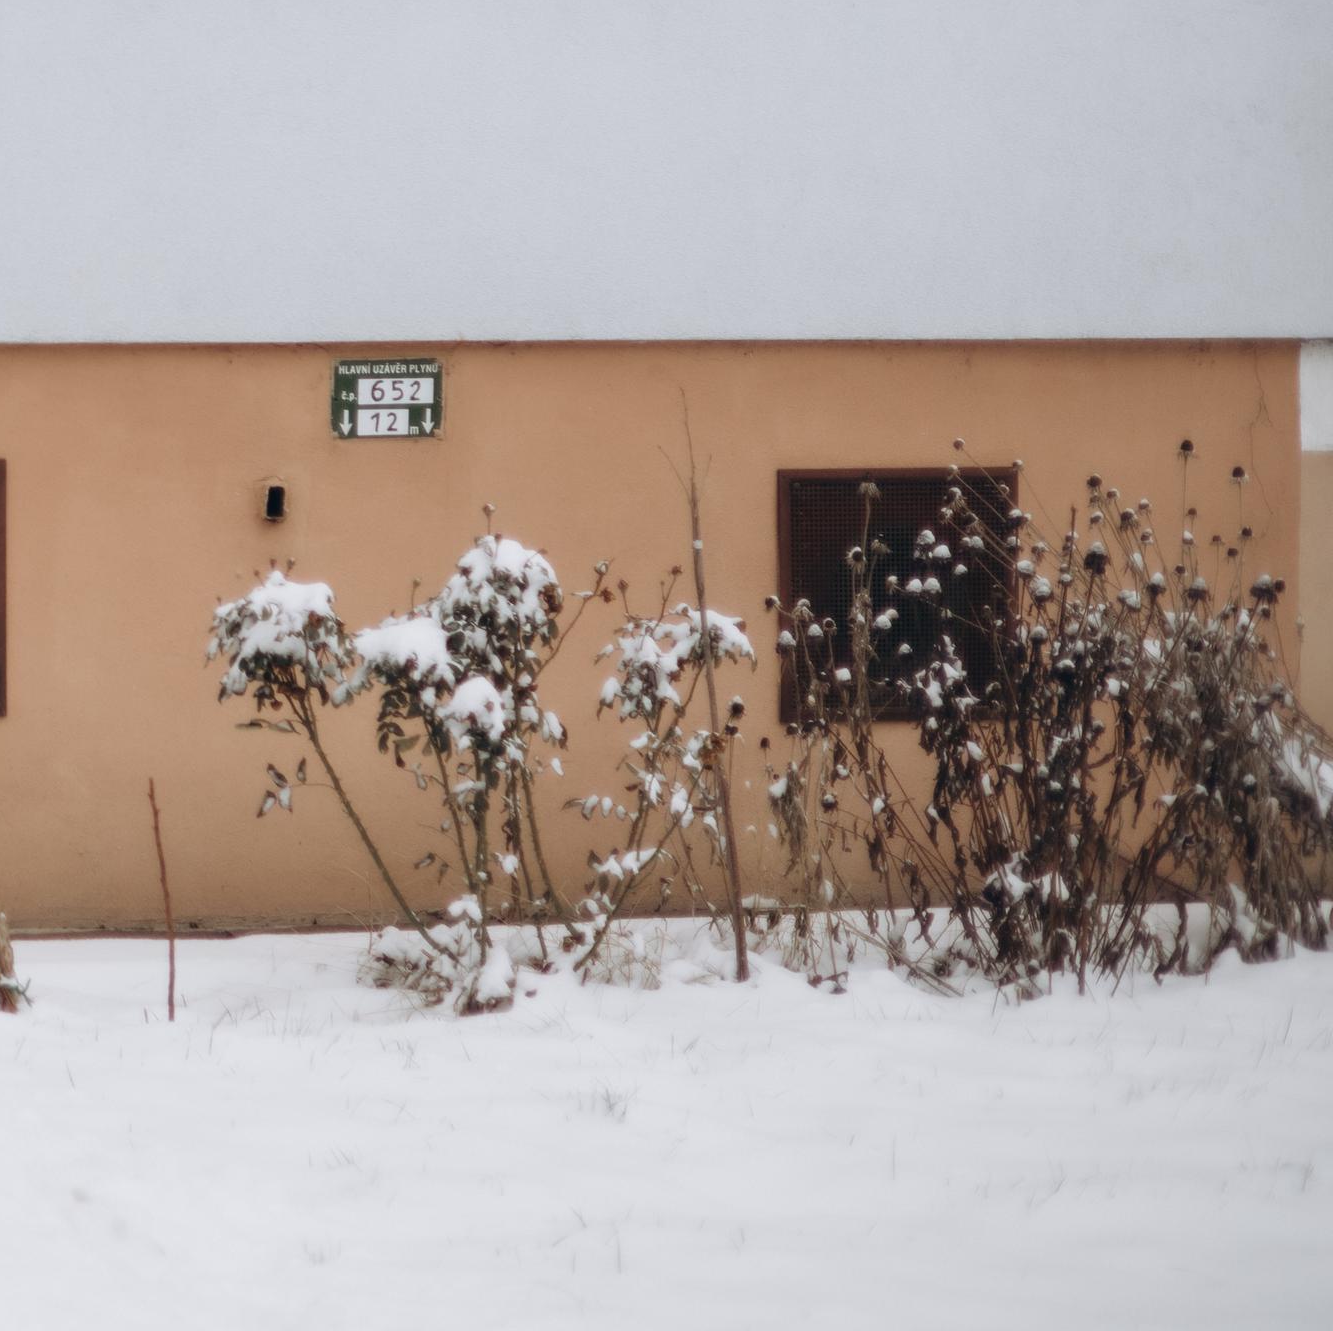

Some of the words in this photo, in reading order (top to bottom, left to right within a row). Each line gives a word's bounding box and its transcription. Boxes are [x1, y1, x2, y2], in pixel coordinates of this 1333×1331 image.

[339, 363, 371, 375] HLAVNÍ
[372, 362, 407, 374] UZÁVĚR
[341, 390, 357, 403] č.p.
[371, 379, 422, 402] 652
[370, 412, 397, 432] 12
[409, 426, 420, 435] m
